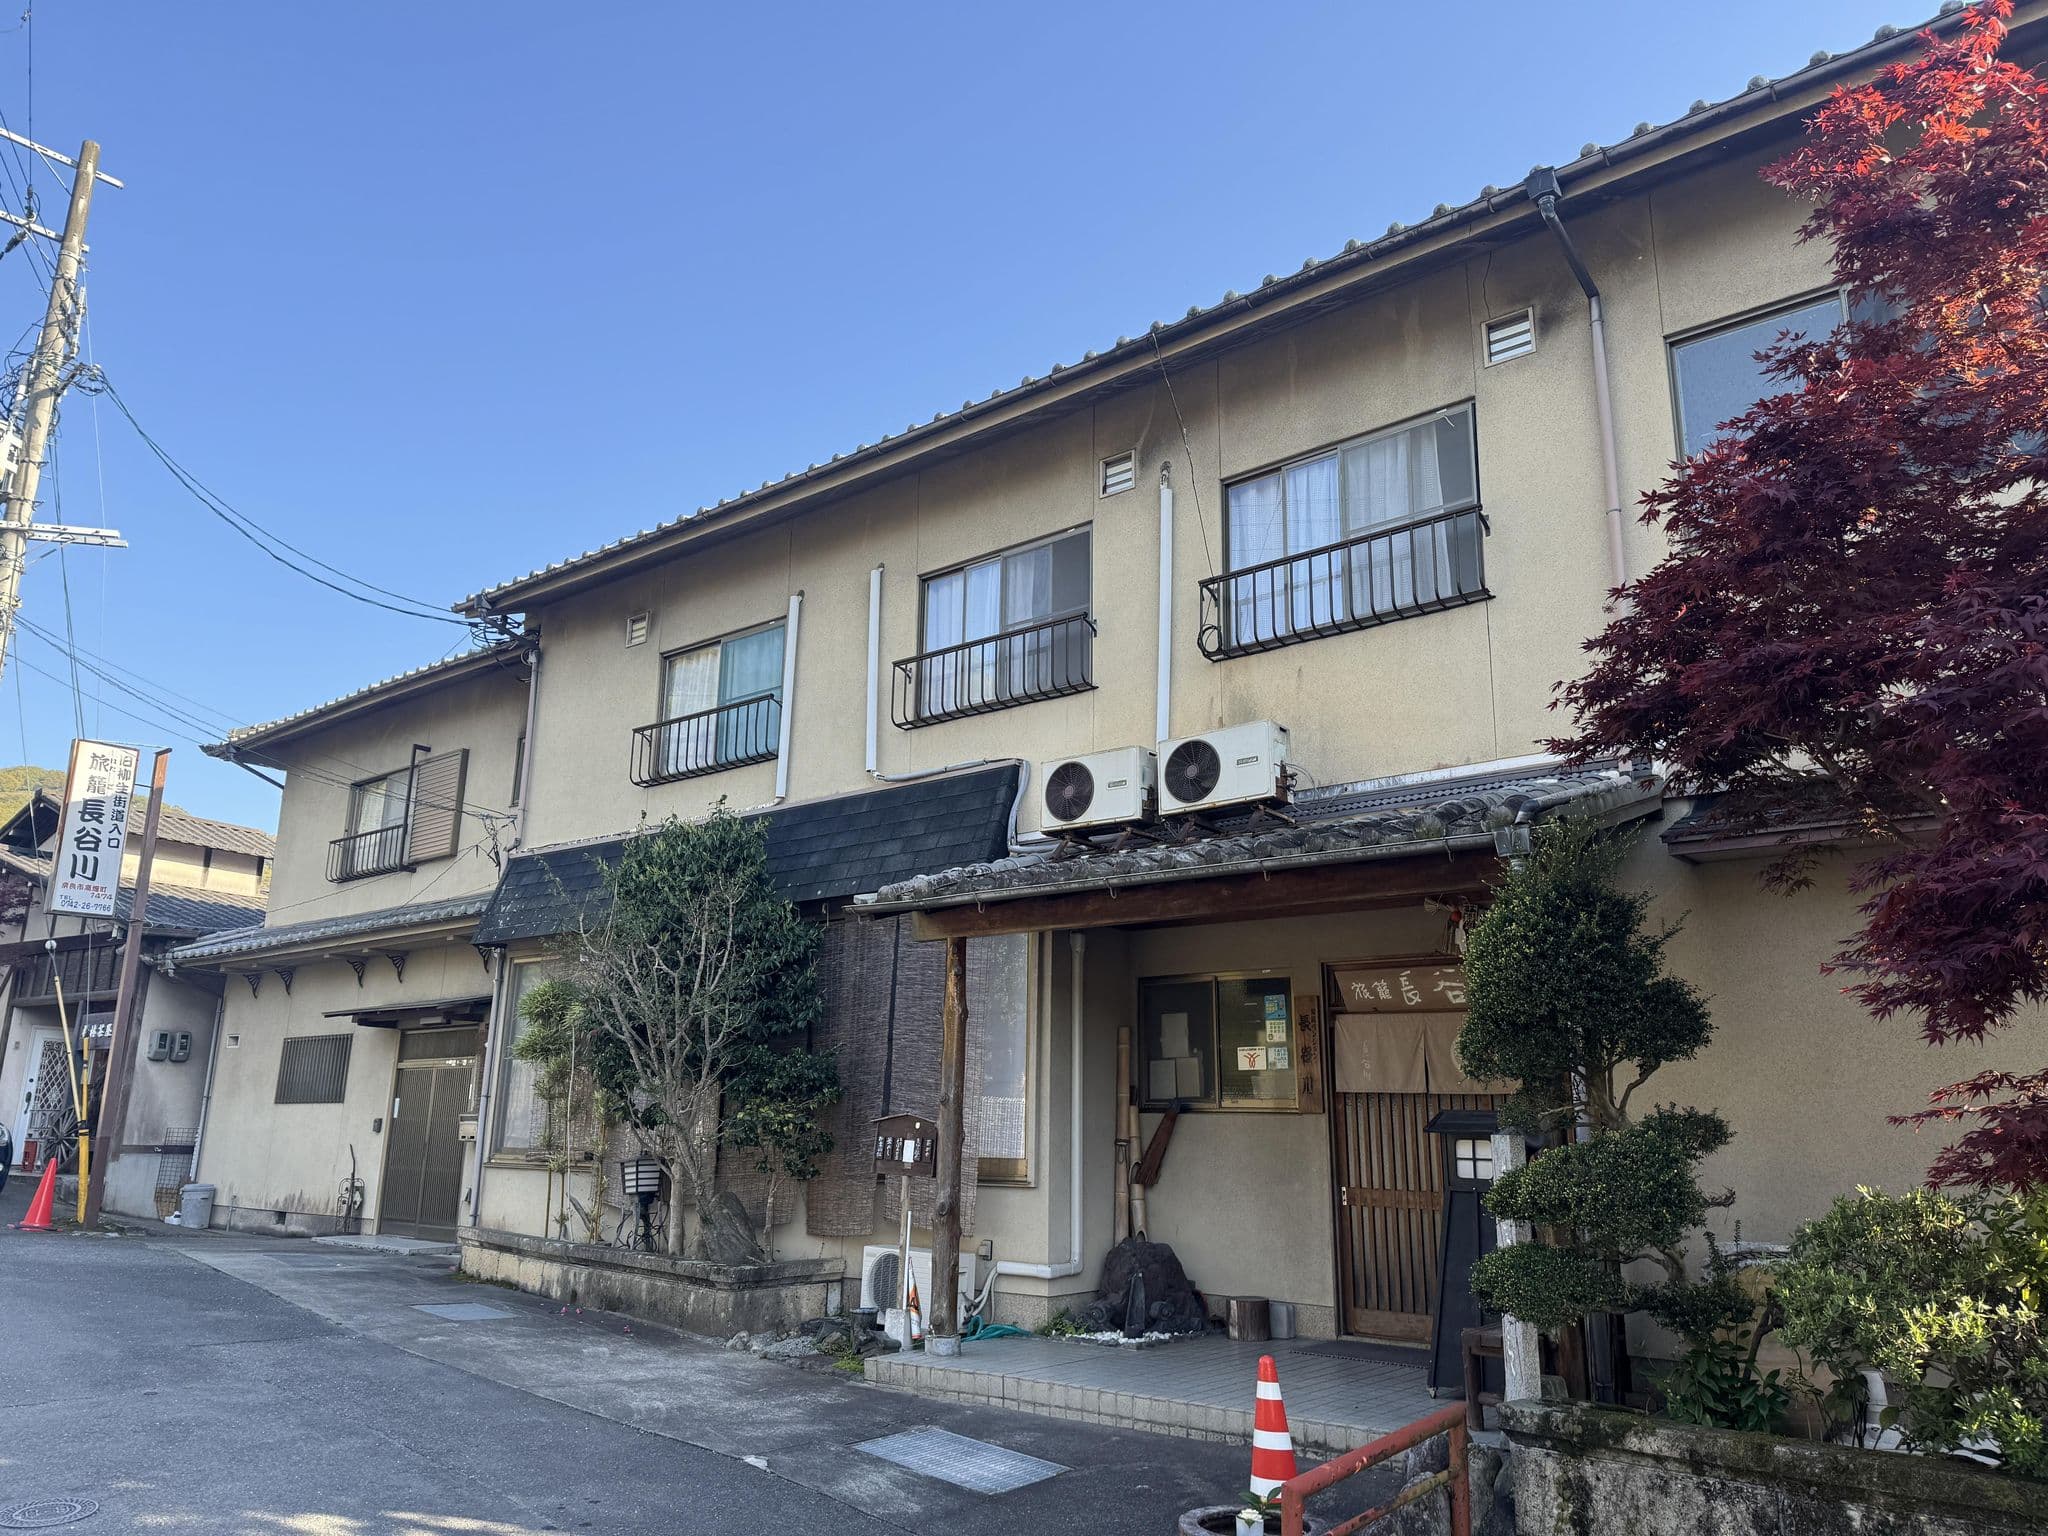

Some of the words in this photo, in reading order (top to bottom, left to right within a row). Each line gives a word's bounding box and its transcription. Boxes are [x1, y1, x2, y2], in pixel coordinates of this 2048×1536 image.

[107, 755, 133, 849] 旧柳生街道入口
[59, 894, 73, 902] TEL
[60, 899, 112, 912] 0742-26-7766
